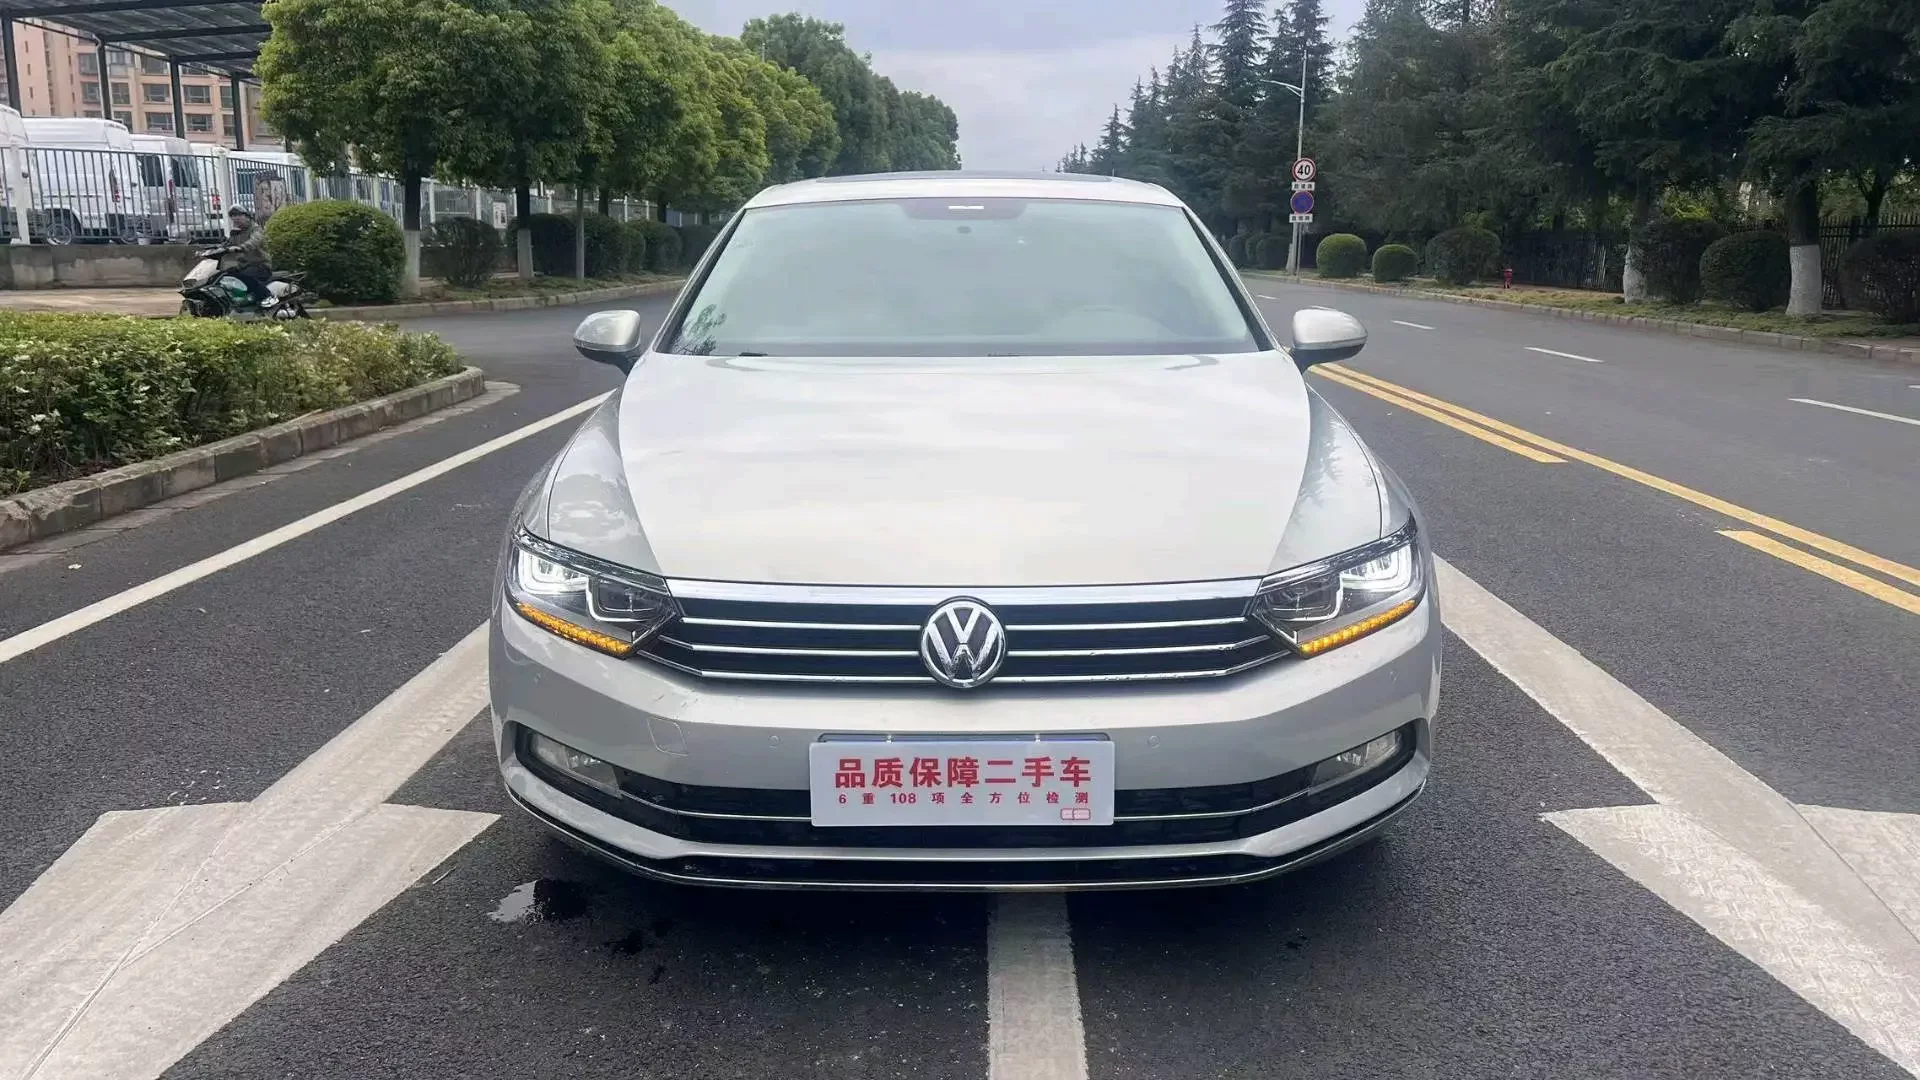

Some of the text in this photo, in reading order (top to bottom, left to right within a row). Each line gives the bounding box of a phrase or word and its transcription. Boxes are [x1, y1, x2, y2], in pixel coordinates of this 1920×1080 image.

[1297, 165, 1311, 176] 40
[925, 603, 1001, 682] VW
[835, 756, 1092, 788] 品质保障二手车
